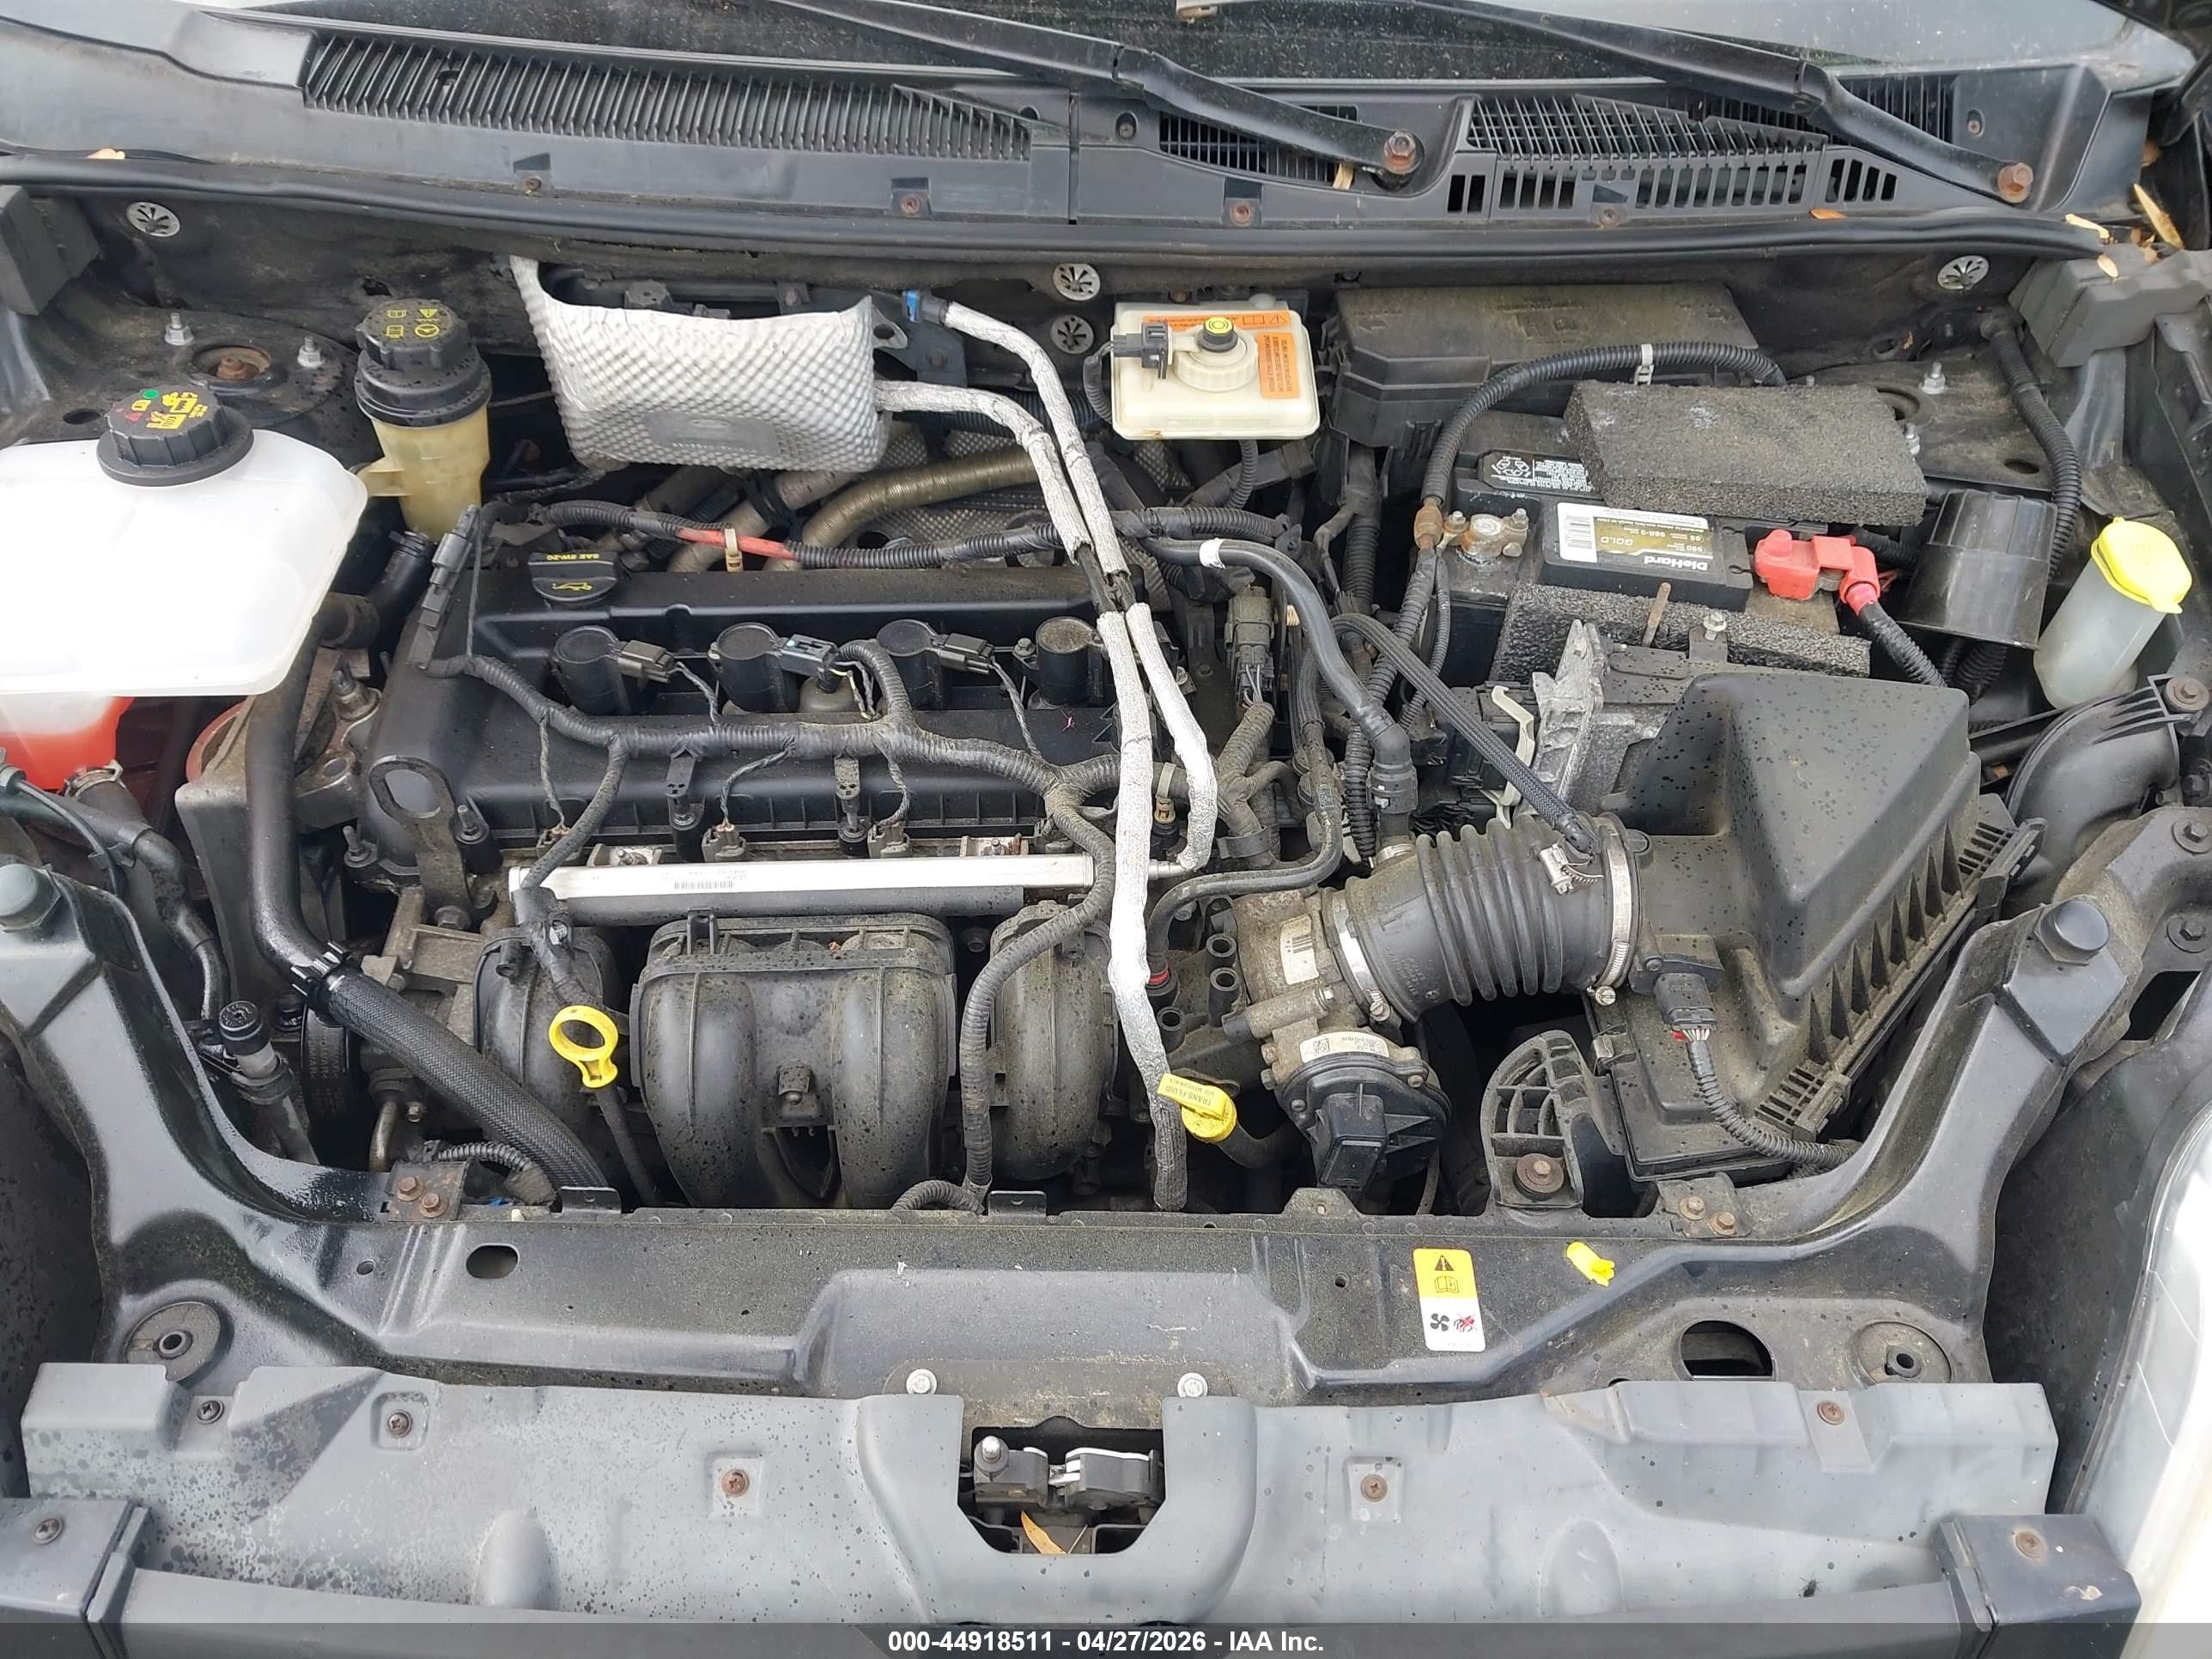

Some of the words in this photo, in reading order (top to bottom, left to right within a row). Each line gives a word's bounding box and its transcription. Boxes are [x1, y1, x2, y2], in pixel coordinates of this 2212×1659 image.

[1600, 536, 1634, 546] GOLD
[1644, 555, 1709, 571] DieHard
[1165, 1085, 1187, 1097] FLUID
[1188, 1092, 1212, 1106] TRANS
